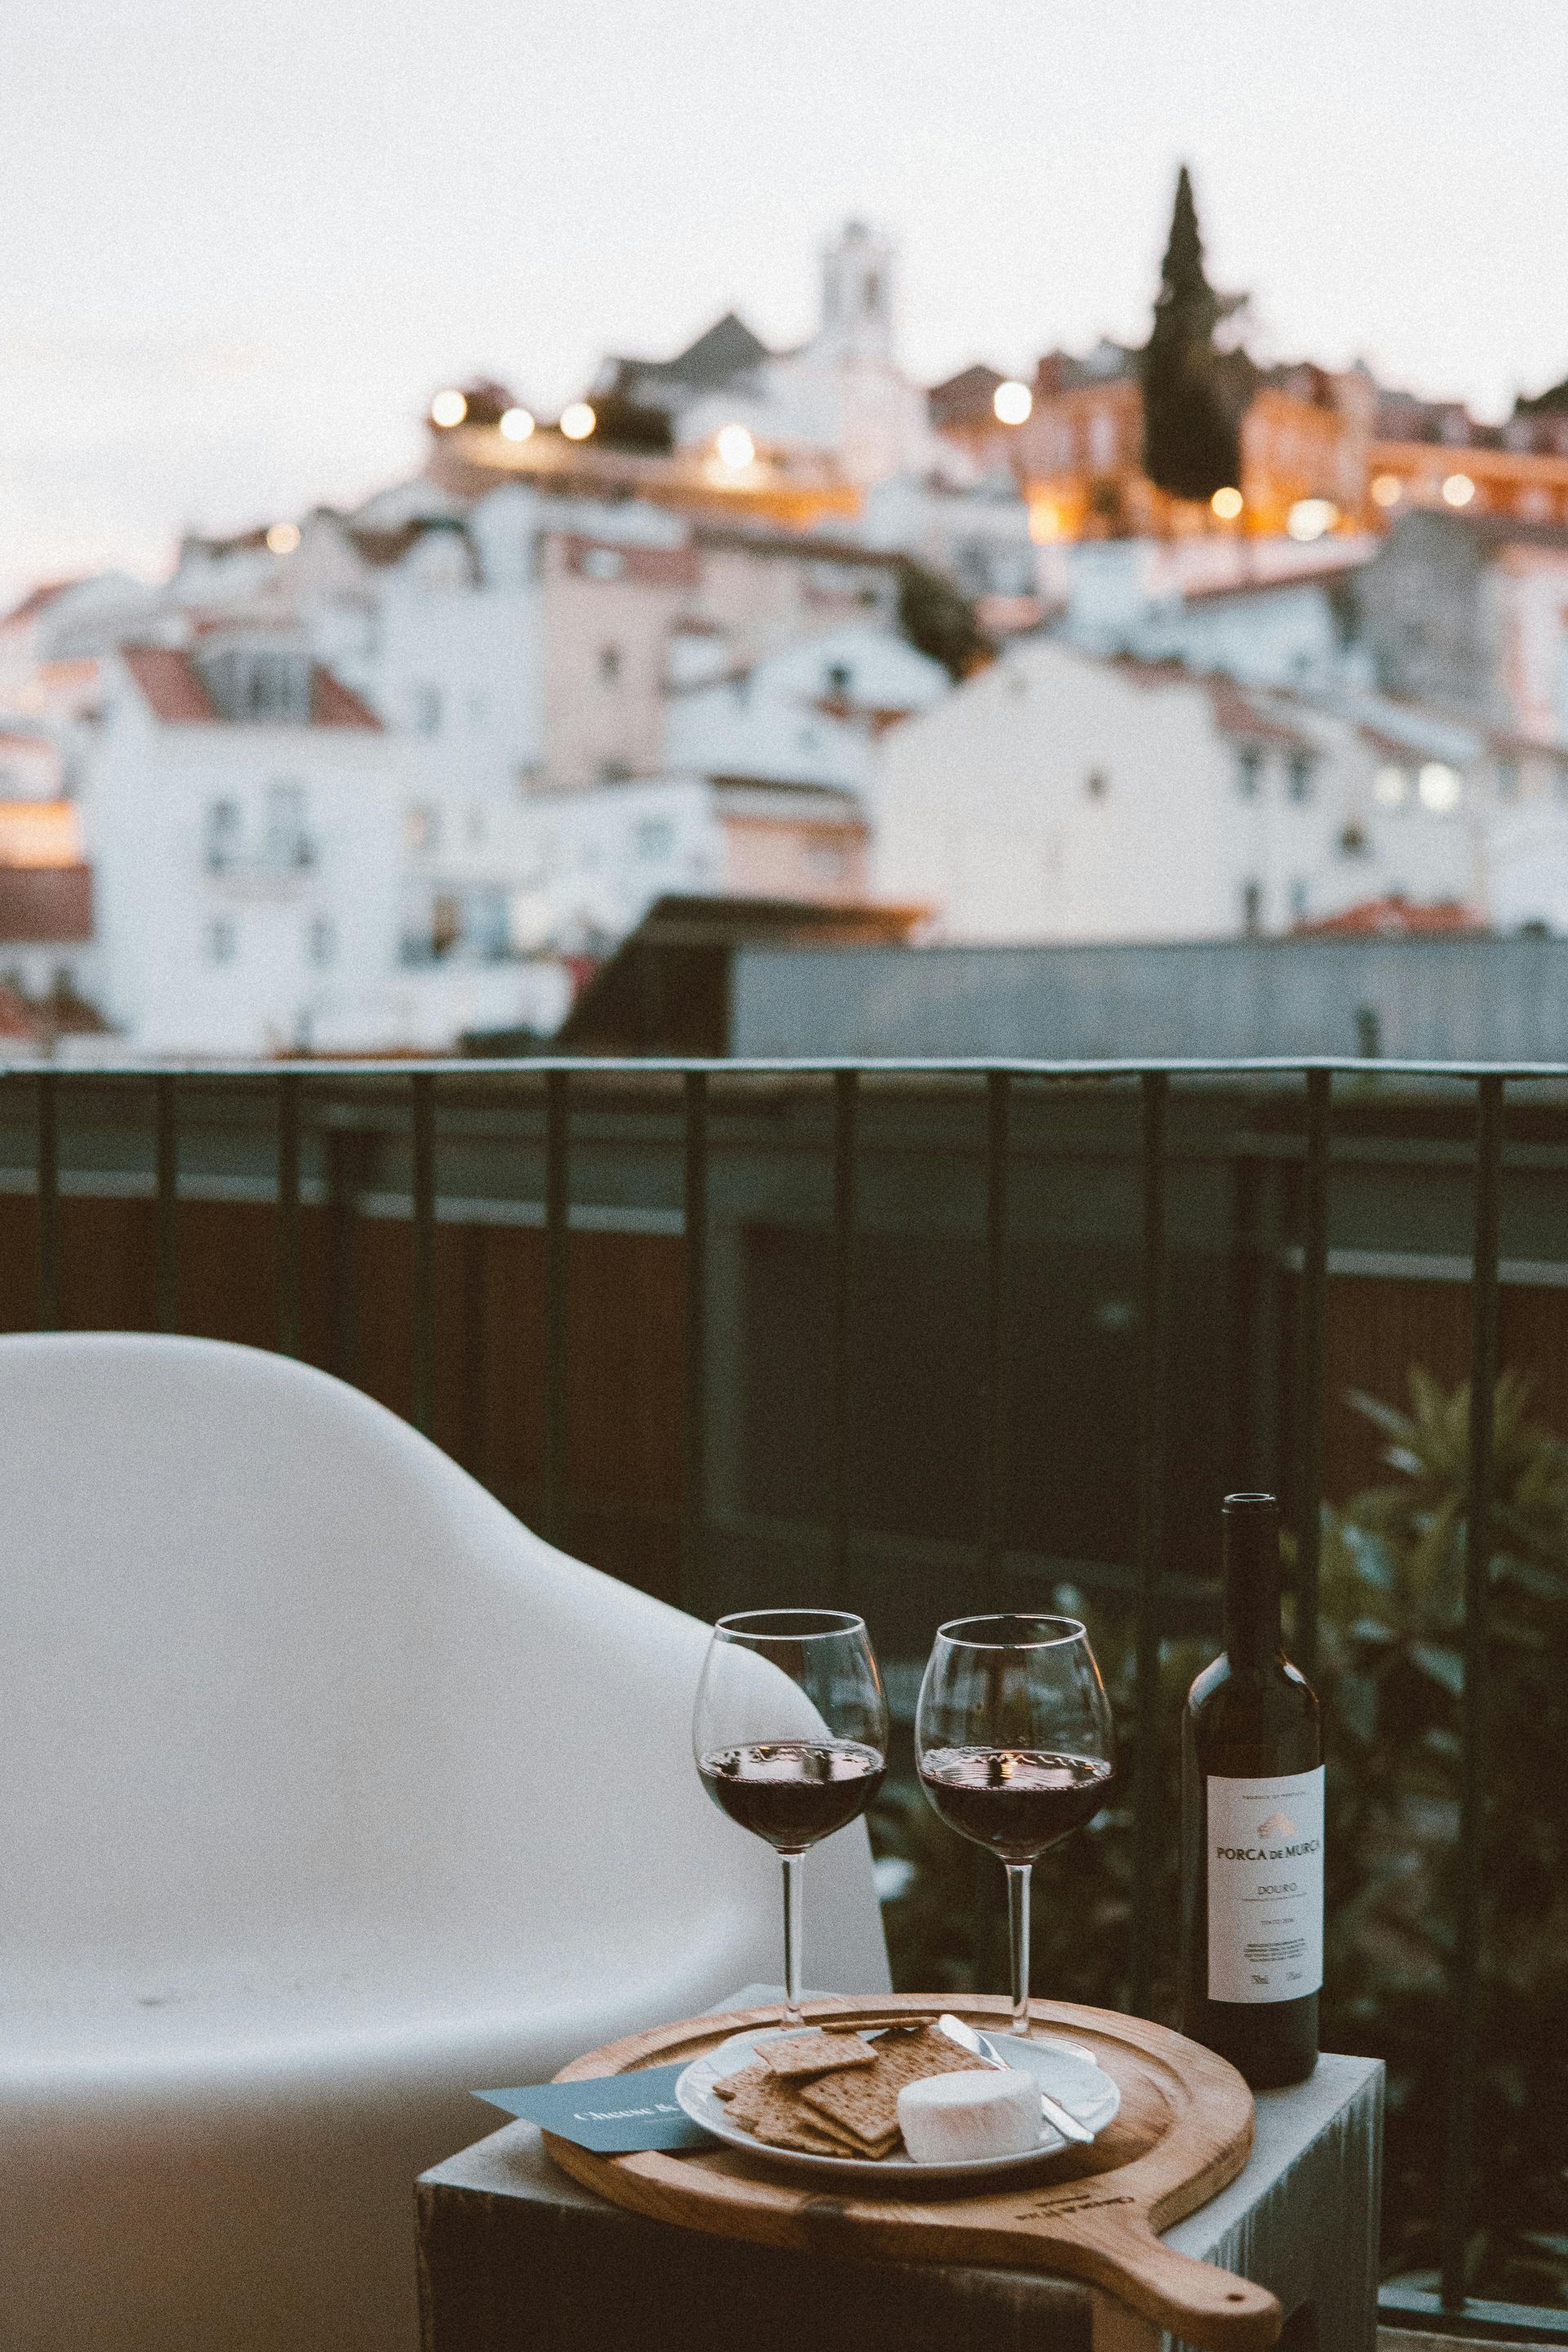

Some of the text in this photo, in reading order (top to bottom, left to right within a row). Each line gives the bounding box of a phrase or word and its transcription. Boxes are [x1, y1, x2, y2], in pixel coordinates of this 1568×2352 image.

[1217, 1846, 1267, 1860] PORCA
[1269, 1850, 1284, 1860] DE
[1258, 1882, 1298, 1895] DOURO
[573, 2107, 655, 2121] Cheese
